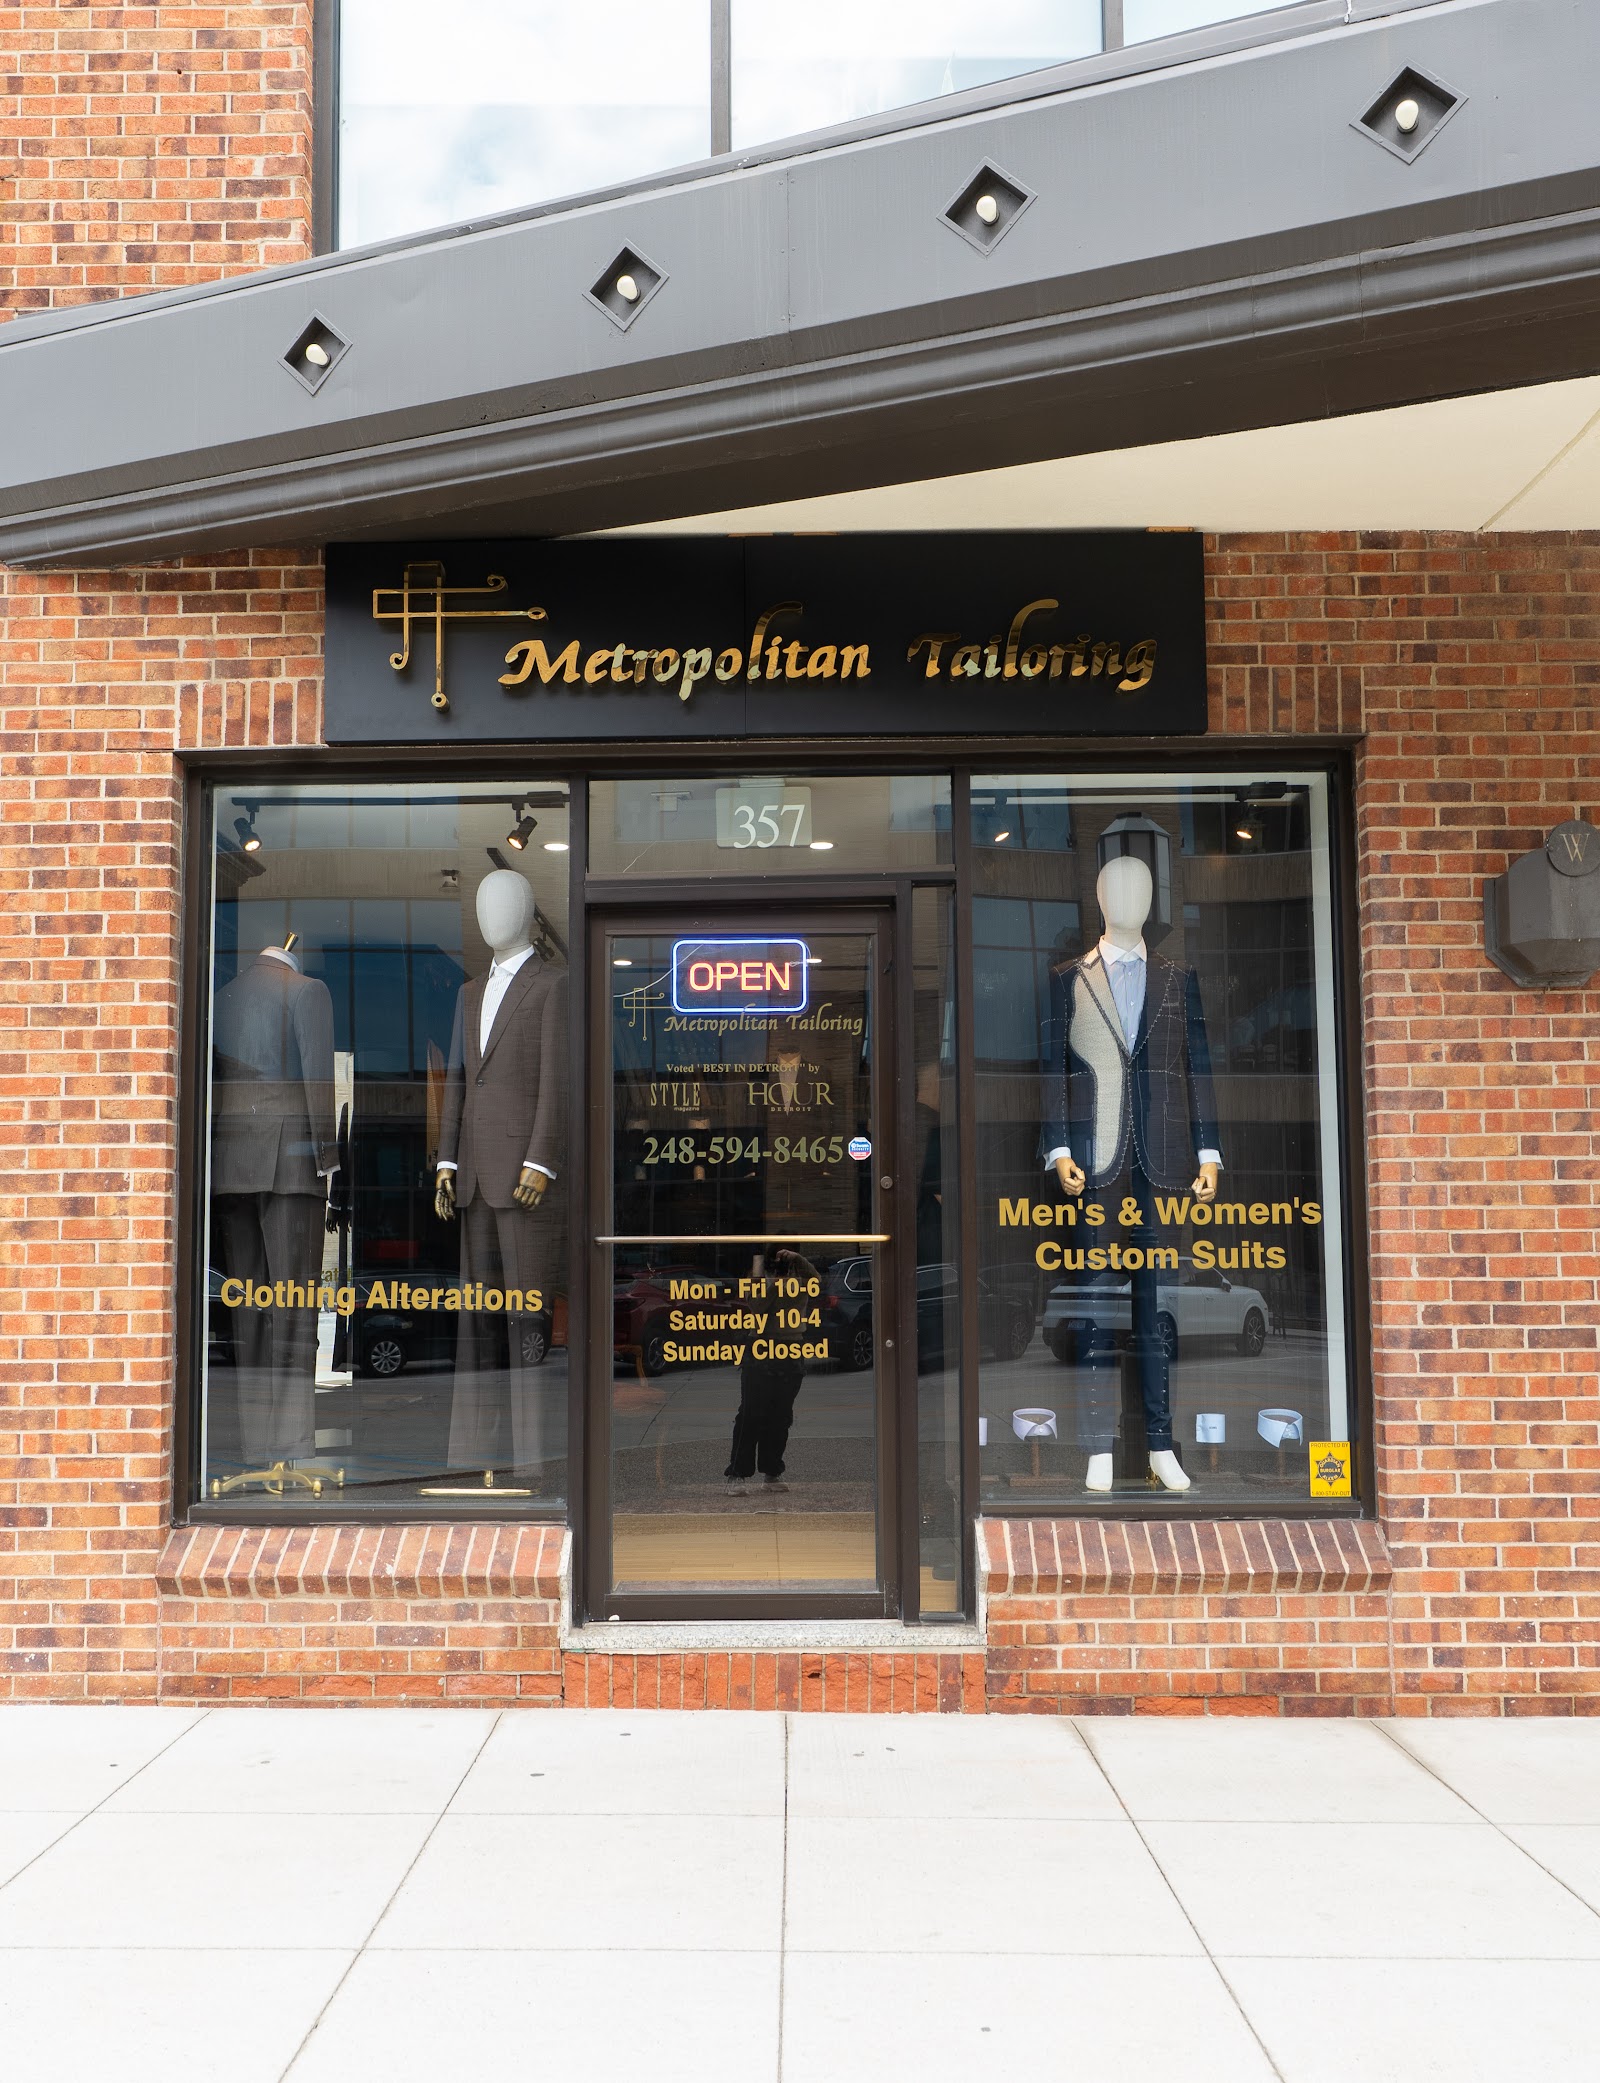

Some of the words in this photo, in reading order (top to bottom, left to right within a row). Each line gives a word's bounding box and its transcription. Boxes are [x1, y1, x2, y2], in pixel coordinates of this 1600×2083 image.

[498, 601, 871, 700] Metropolitan
[907, 599, 1157, 691] Tailoring
[733, 804, 805, 848] 357
[1560, 833, 1590, 862] W
[689, 962, 791, 991] OPEN
[664, 1004, 778, 1036] Metropolitan
[786, 1003, 863, 1035] Tailoring
[666, 1063, 694, 1073] Voted
[734, 1063, 746, 1073] IN
[808, 1063, 820, 1074] by
[650, 1082, 700, 1107] STYLE
[746, 1082, 835, 1106] HOUR
[642, 1136, 844, 1164] 248-594-8465
[998, 1197, 1106, 1226] Men's
[1118, 1197, 1143, 1226] &
[1154, 1196, 1322, 1226] Women's
[1035, 1241, 1179, 1271] Custom
[1192, 1240, 1287, 1270] Suits
[220, 1278, 356, 1316] Clothing
[365, 1280, 543, 1312] Alterations
[669, 1279, 717, 1300] Mon
[738, 1278, 767, 1299] Fri
[775, 1277, 820, 1298] 10-6
[669, 1309, 768, 1334] Saturday
[775, 1308, 821, 1328] 10-4
[663, 1340, 745, 1366] Sunday
[752, 1338, 829, 1360] Closed
